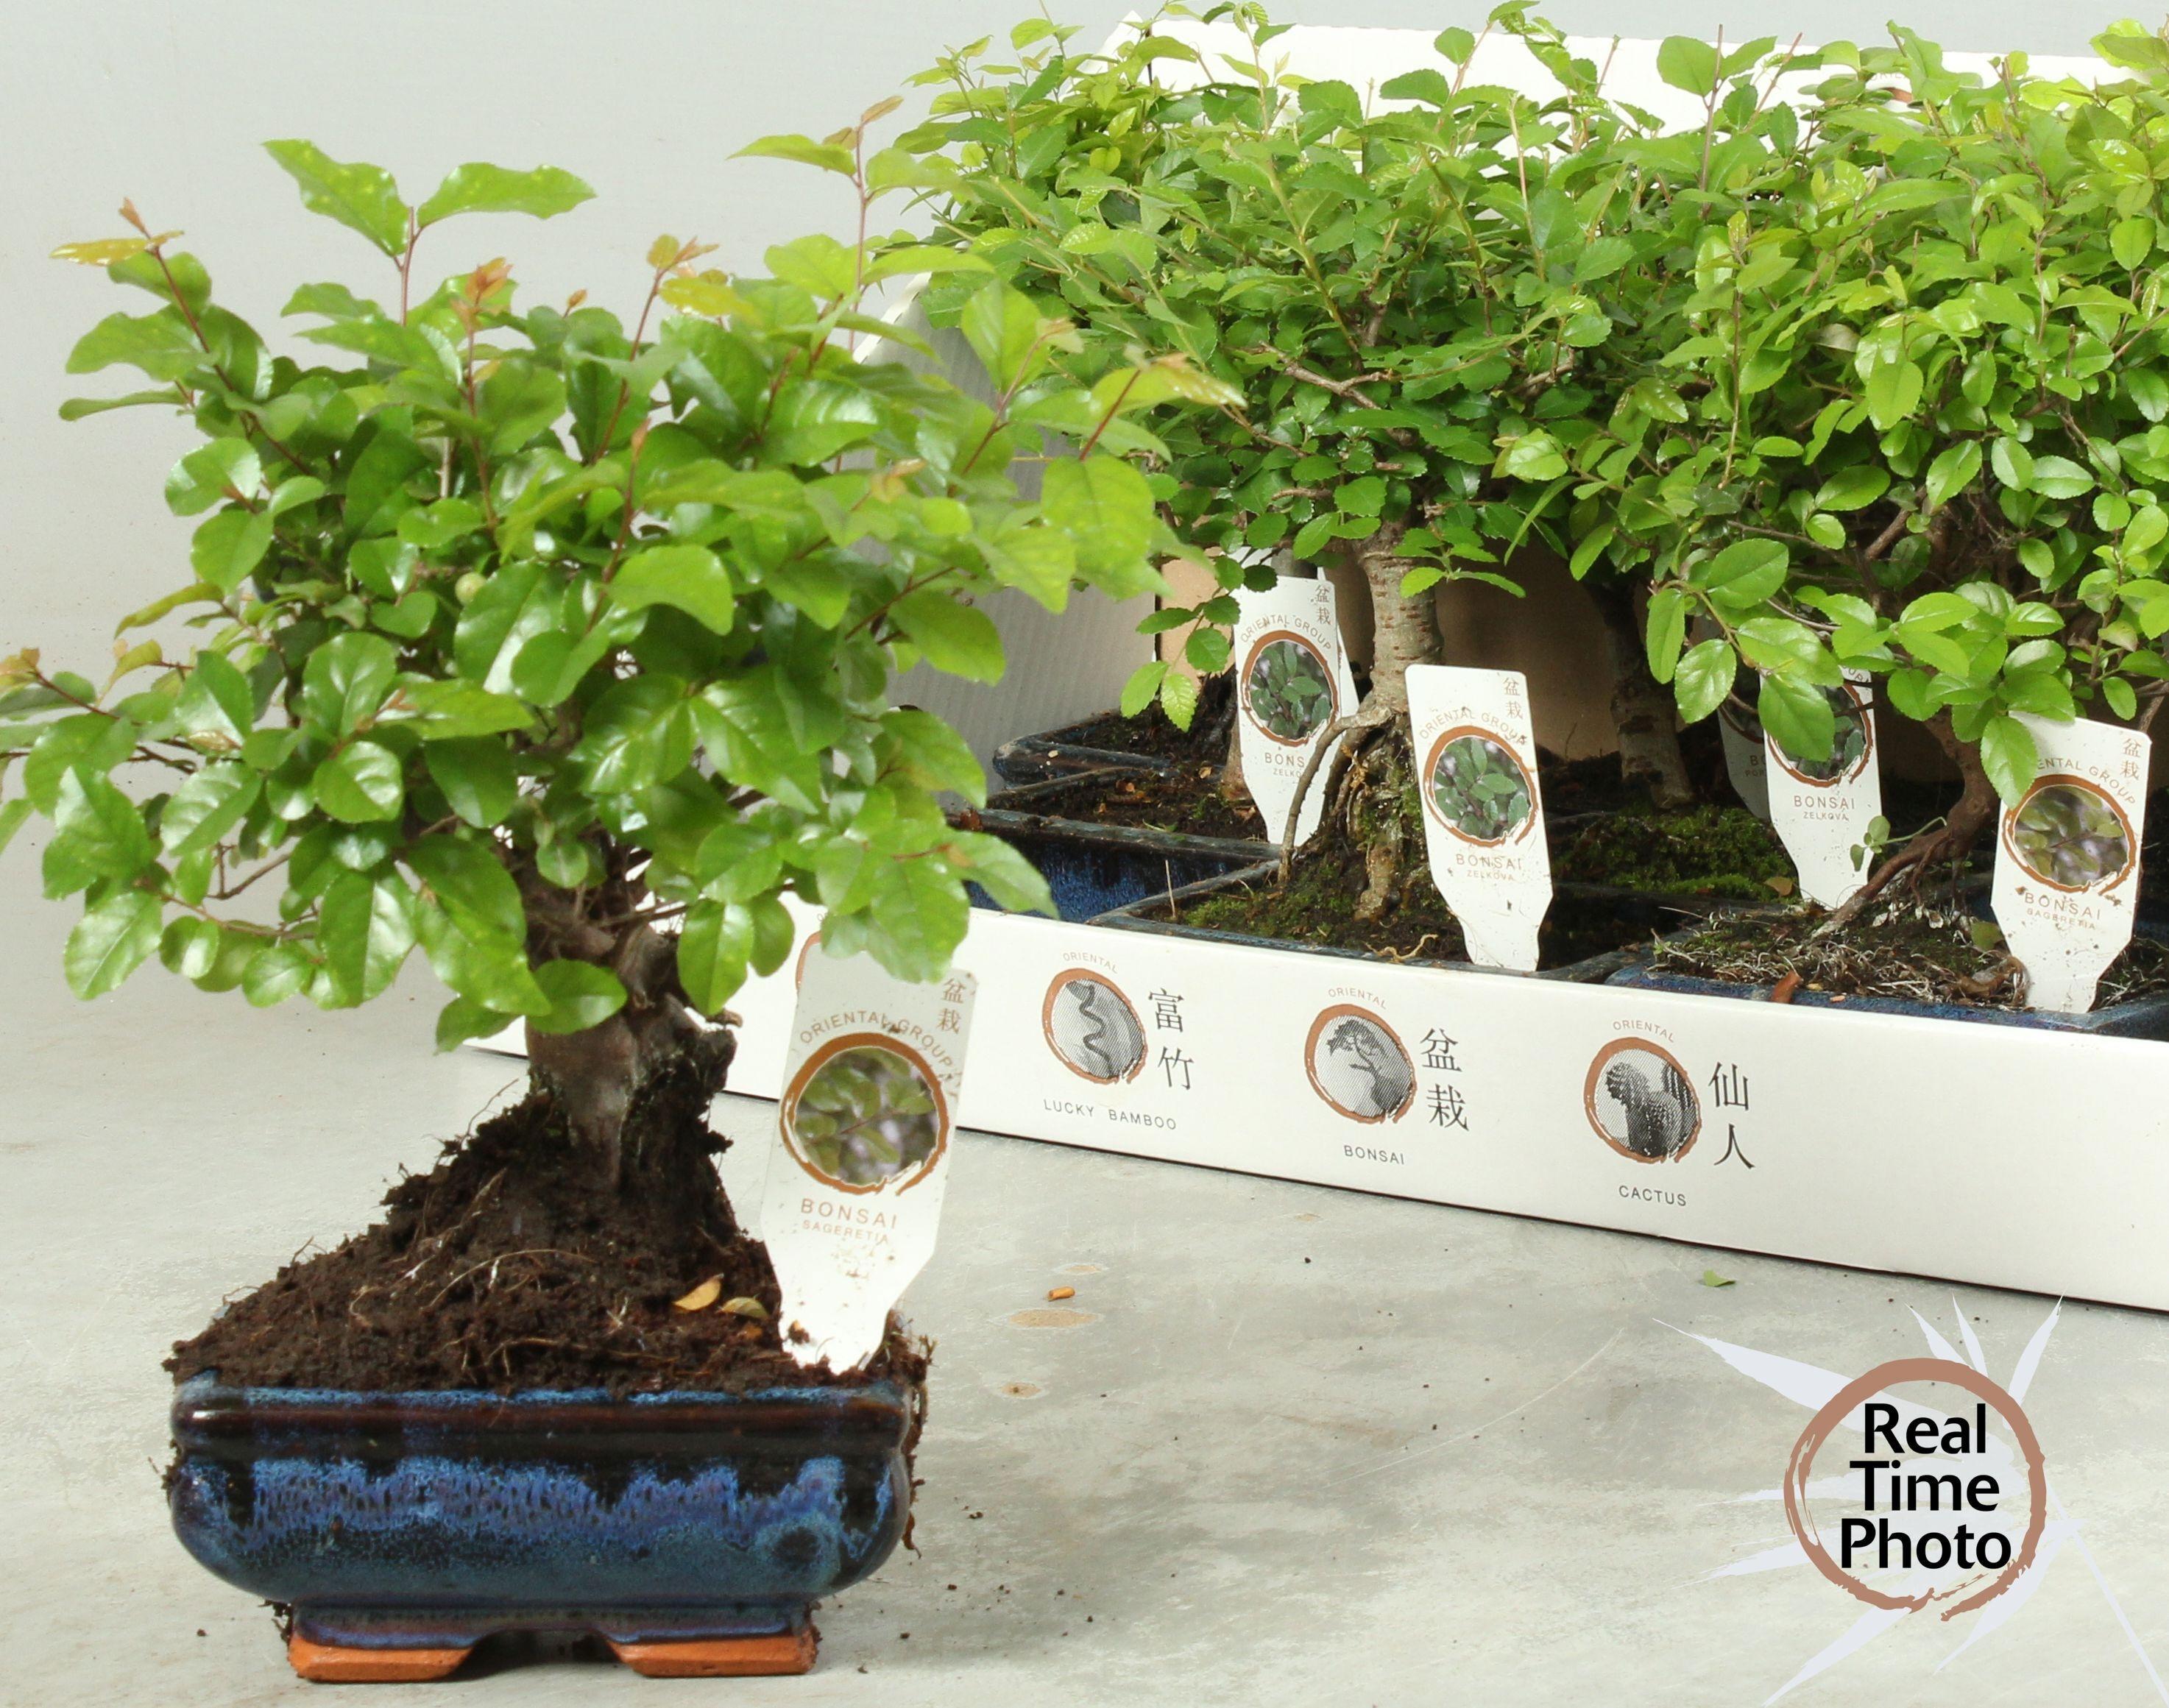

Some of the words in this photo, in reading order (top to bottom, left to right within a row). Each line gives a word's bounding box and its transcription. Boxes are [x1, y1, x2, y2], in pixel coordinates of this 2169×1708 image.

[1315, 584, 1331, 626] 盆栽
[1241, 614, 1289, 643] ORIENTAL
[1295, 617, 1331, 651] GROUP
[1503, 677, 1524, 720] 盆栽
[1420, 708, 1475, 740] ORIENTAL
[1264, 752, 1305, 768] BONS
[1273, 768, 1302, 778] ZELKO
[2120, 738, 2142, 781] 盆栽
[2038, 757, 2083, 770] ENTAL
[2089, 766, 2135, 804] GROUP
[1794, 795, 1855, 809] BONSAI
[1803, 812, 1849, 821] ZELKOVA
[1456, 854, 1521, 871] BONSAI
[1467, 870, 1514, 882] ZELKOVA
[2025, 892, 2100, 920] BONSAI
[2027, 908, 2095, 930] SAGERETIA
[1063, 952, 1118, 974] ORIENTAL
[936, 977, 966, 1035] 盆栽
[1328, 987, 1387, 1010] ORIENTAL
[800, 1010, 888, 1044] ORIENTAL
[897, 1018, 953, 1068] GROUP
[1148, 987, 1194, 1091] 富竹
[1613, 1020, 1674, 1043] ORIENTAL
[1420, 1027, 1470, 1132] 盆栽
[1044, 1099, 1094, 1117] LUCKY
[1108, 1109, 1177, 1130] BAMBOO
[1708, 1062, 1755, 1169] 仙人
[1344, 1145, 1404, 1164] BONSAI
[1618, 1185, 1687, 1207] CACTUS
[801, 1198, 896, 1229] BONSAI
[802, 1219, 888, 1244] SAGERETIA
